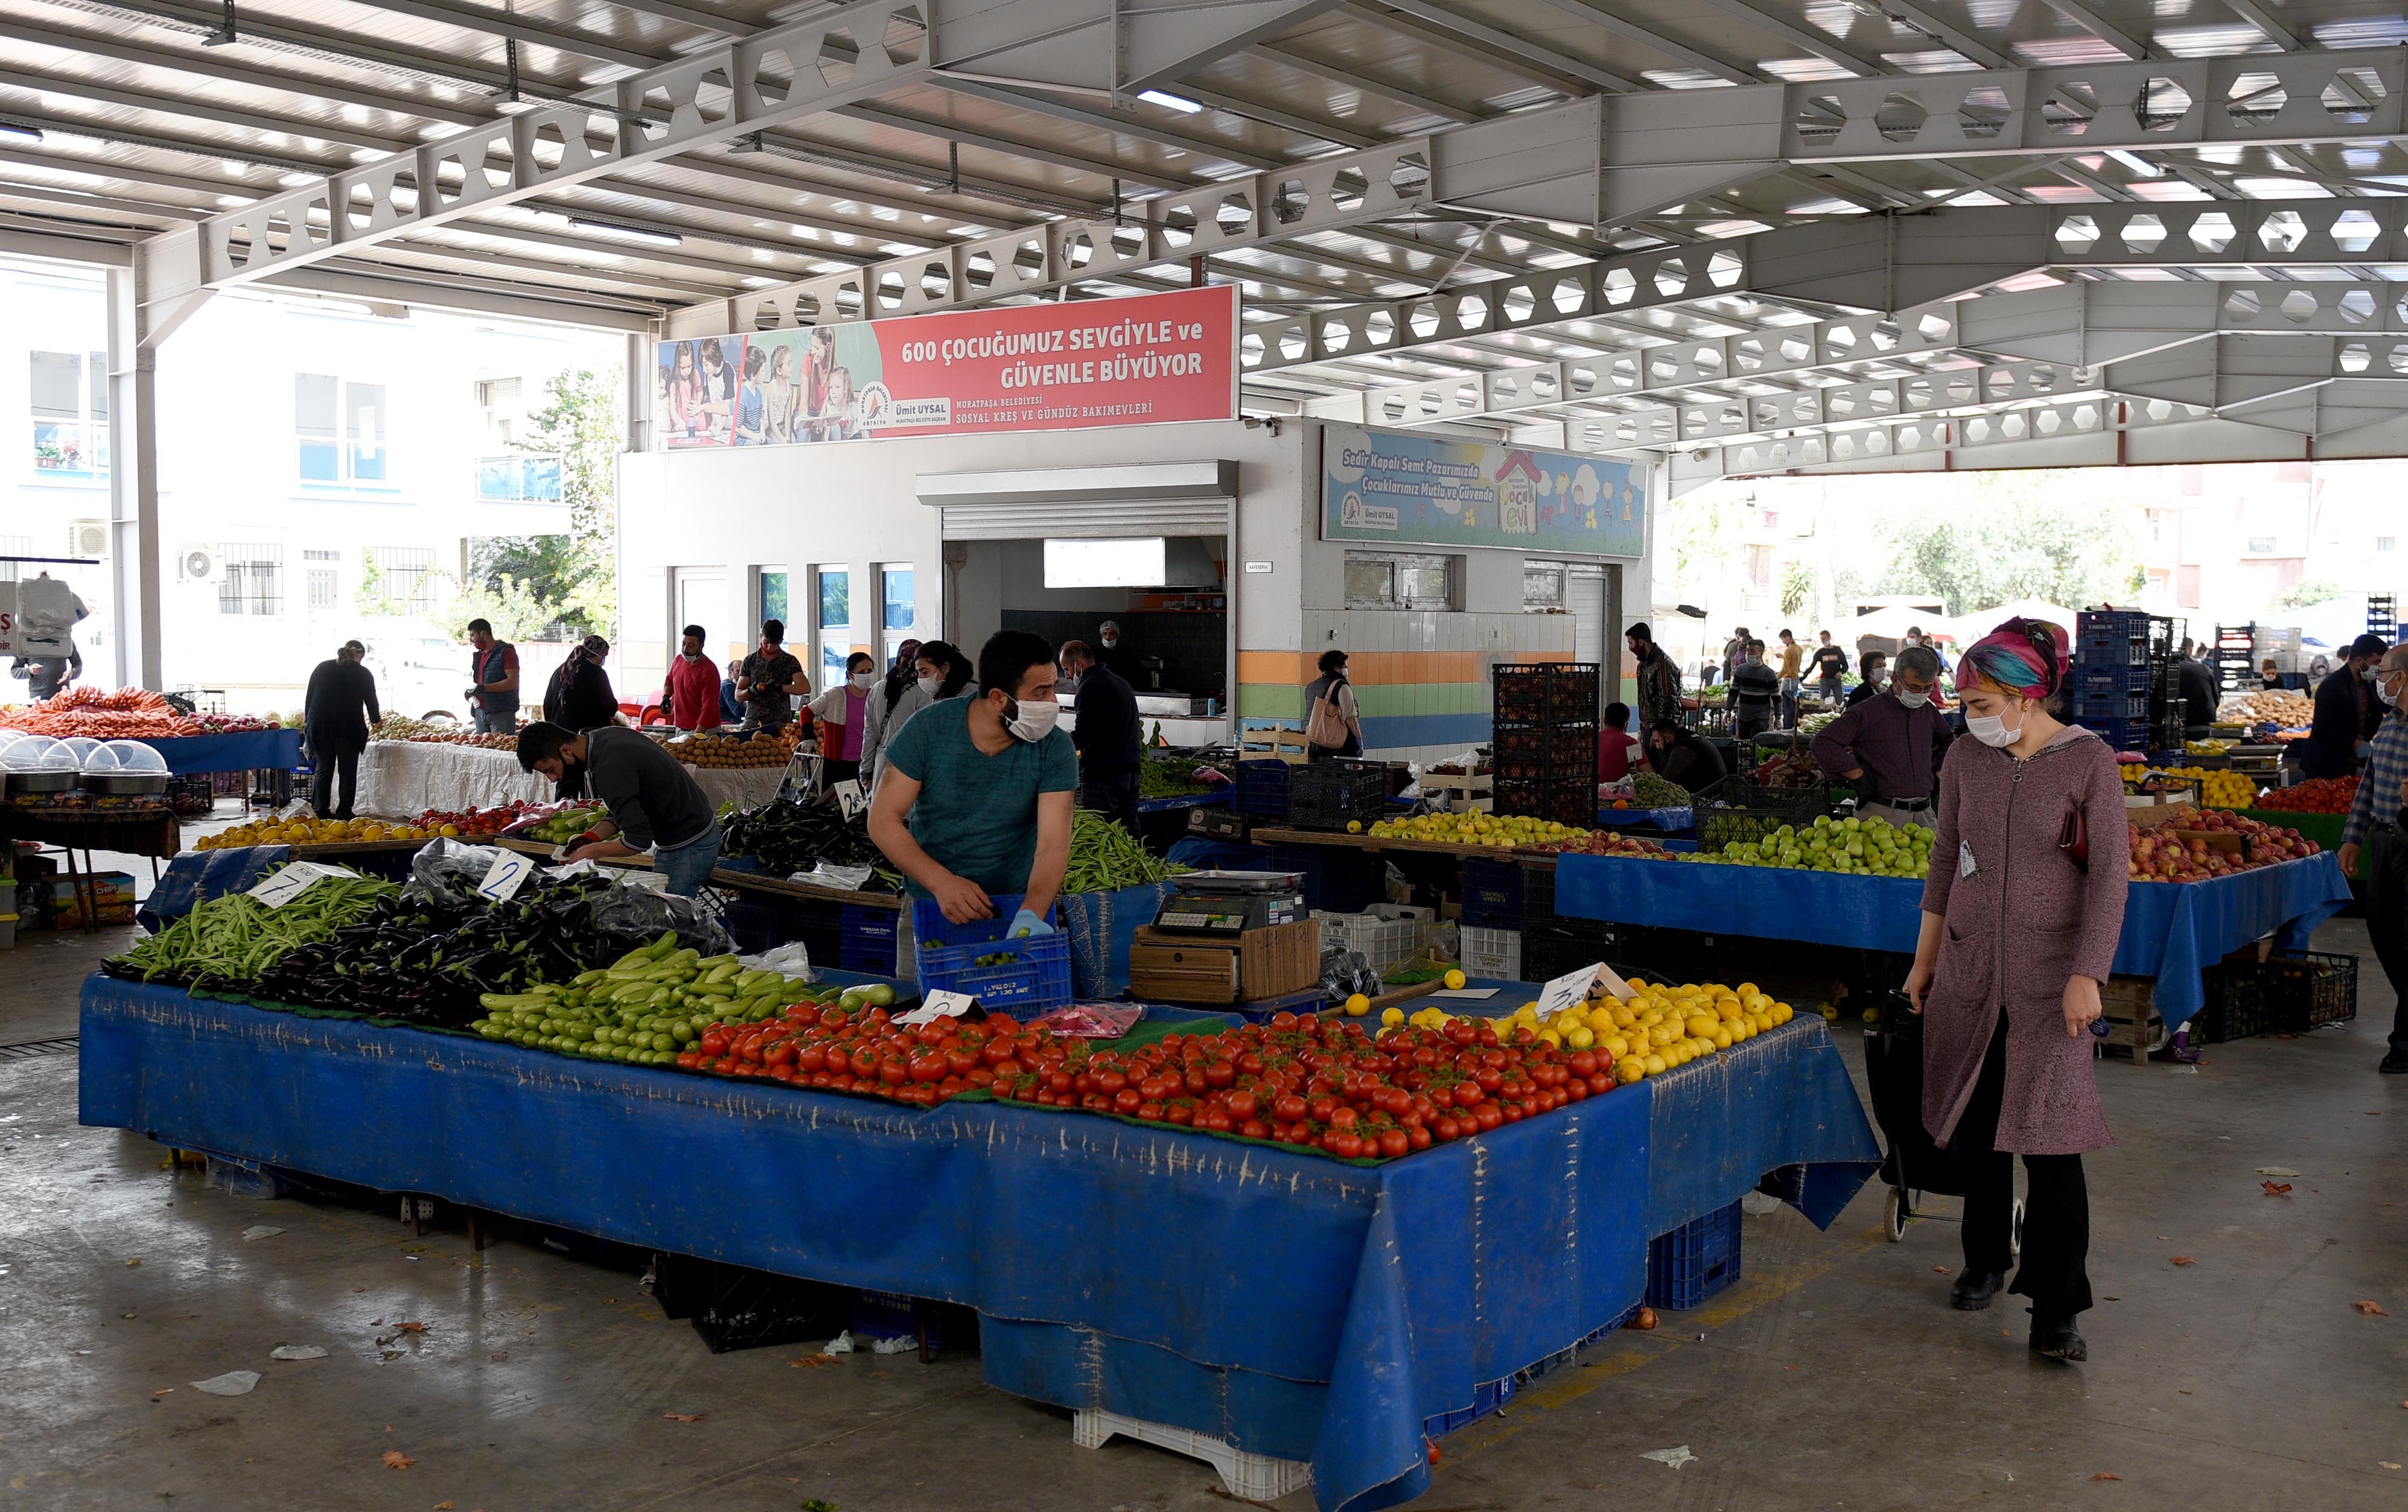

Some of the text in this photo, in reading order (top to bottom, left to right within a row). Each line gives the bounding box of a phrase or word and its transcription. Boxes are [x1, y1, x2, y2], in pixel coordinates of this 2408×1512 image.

[902, 317, 1203, 366] 600 ÇOCUĞUMUZ SEVGİYLE ve
[1001, 350, 1203, 389] GÜVENLE BÜYÜYOR
[896, 404, 946, 416] Ümit UYSAL
[956, 394, 1043, 409] MURATPAŞA BELEDİYESİ
[956, 399, 1153, 424] SOSYAL KREŞ VE GÜNDÜZ BAKIMEVLERİ
[1343, 449, 1479, 477] Sedir Kapalı Semt Pazarımızda
[1362, 477, 1494, 501] Çocuklarımız Mutlu ve Güvende
[1365, 508, 1395, 520] Ümit UYSAL
[1506, 504, 1528, 527] evi
[96, 883, 118, 895] CHIPS
[260, 874, 301, 895] 7
[482, 862, 520, 899] 2
[1541, 987, 1572, 1015] 3
